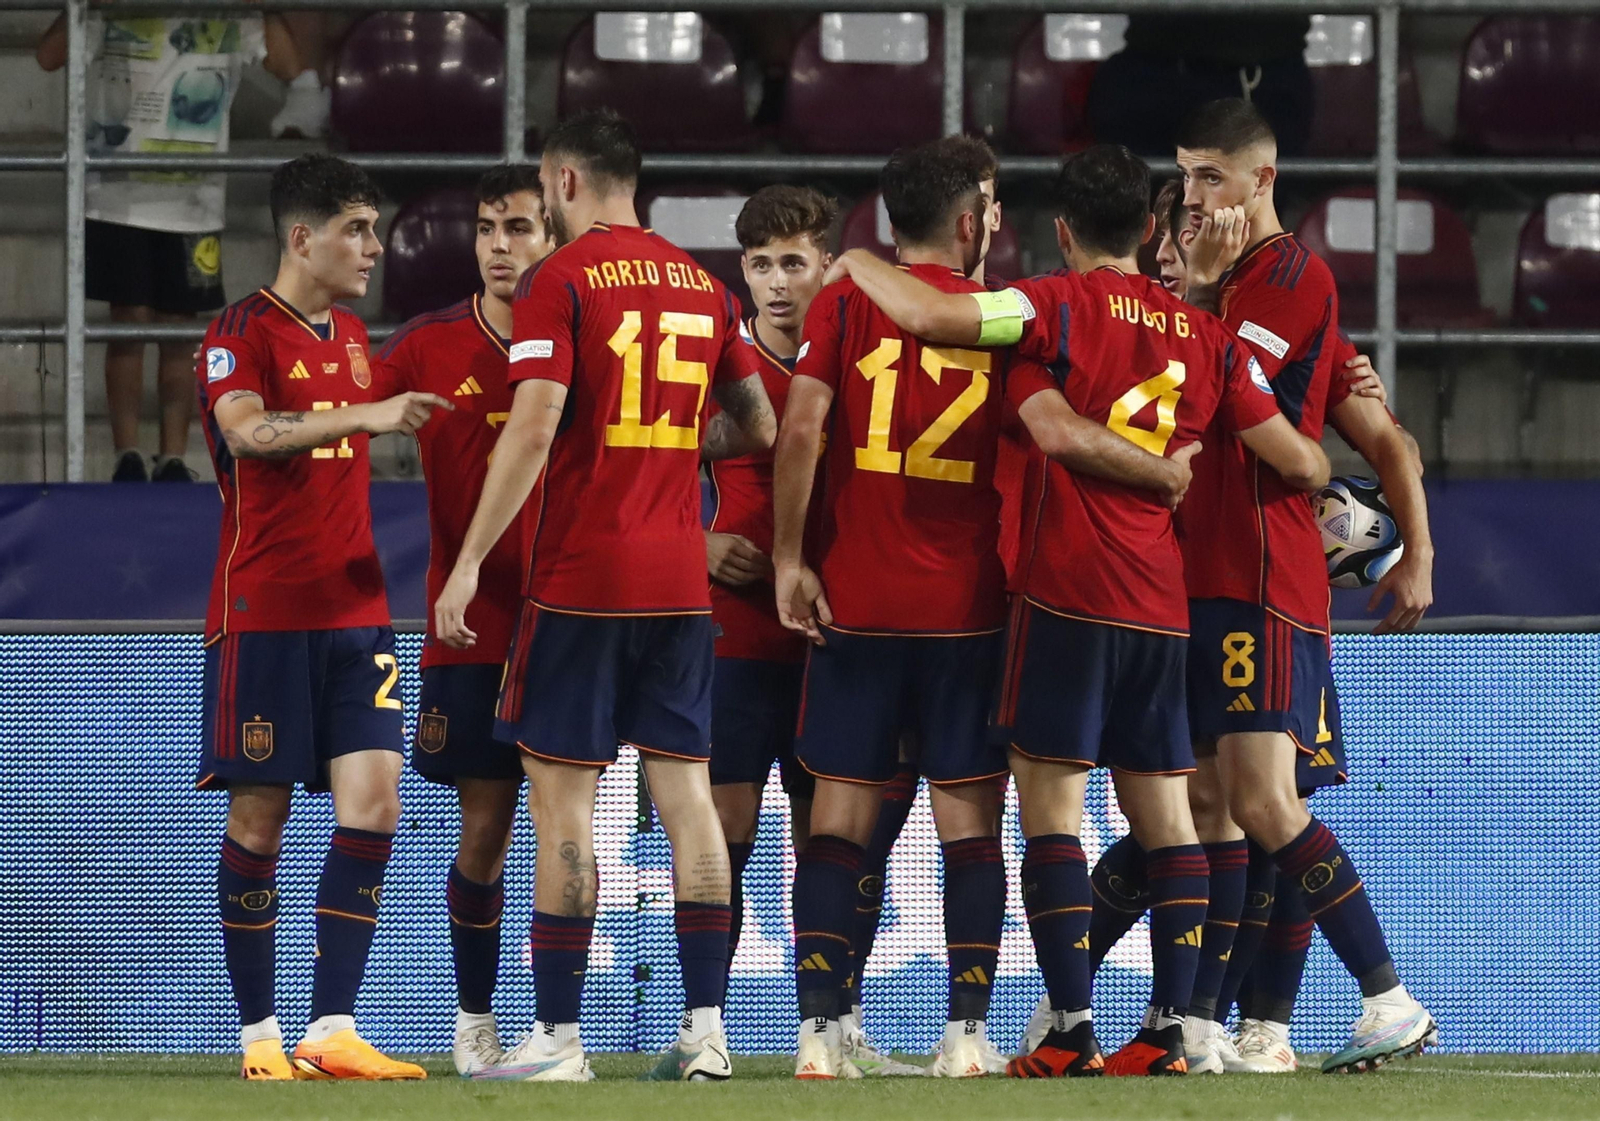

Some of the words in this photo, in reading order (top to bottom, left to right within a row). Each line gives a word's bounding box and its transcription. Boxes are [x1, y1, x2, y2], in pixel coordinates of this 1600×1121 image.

[583, 259, 660, 290] MARIO
[665, 262, 715, 293] GILA
[1174, 312, 1197, 339] G.
[605, 310, 714, 449] 15
[855, 337, 992, 484] 12
[1106, 359, 1187, 458] 4
[1222, 631, 1256, 688] 8
